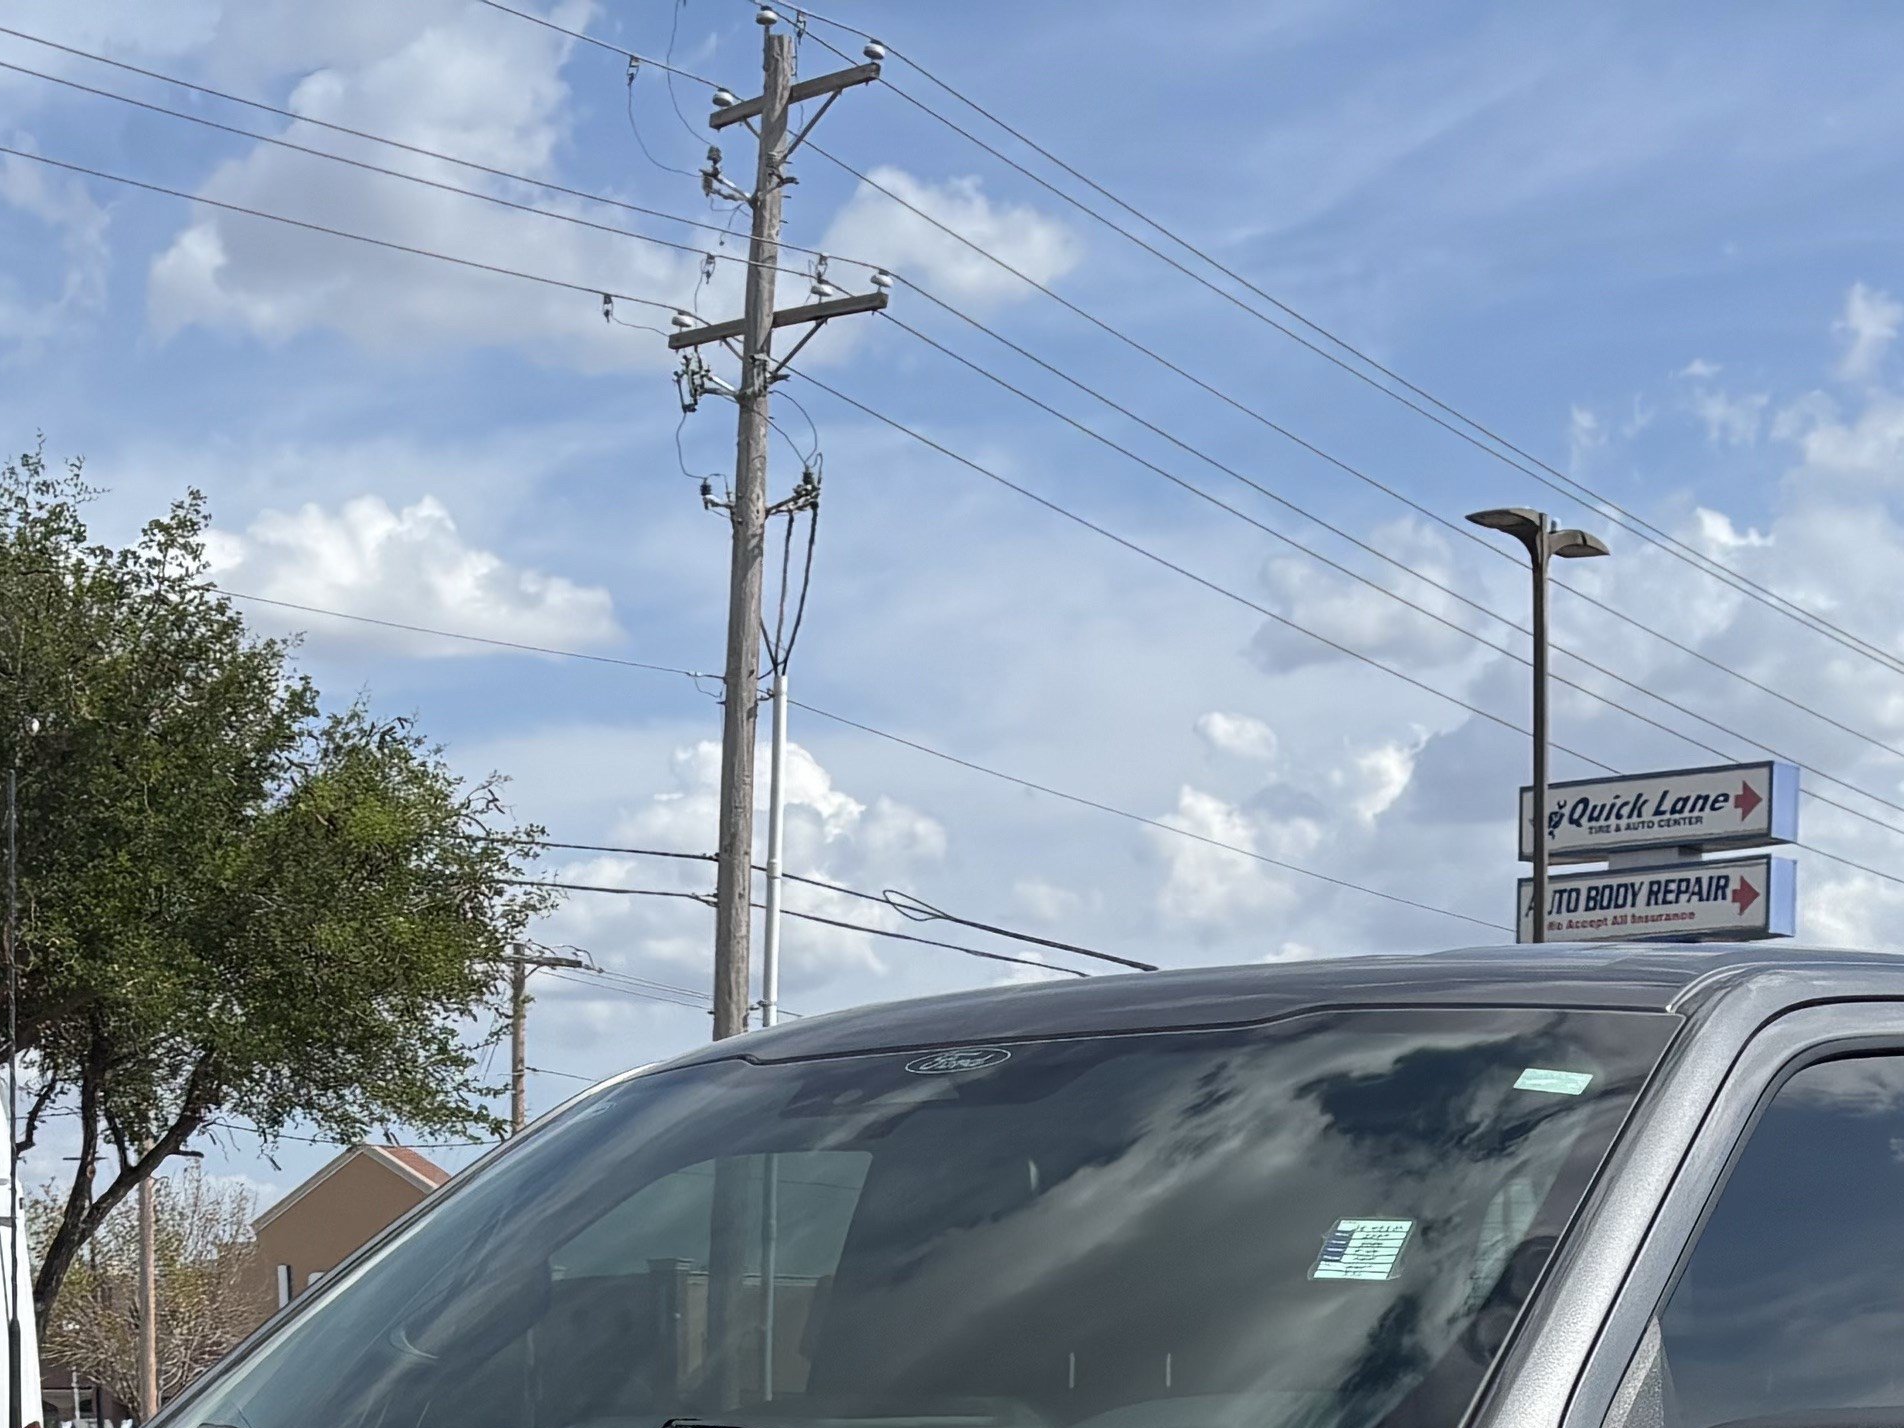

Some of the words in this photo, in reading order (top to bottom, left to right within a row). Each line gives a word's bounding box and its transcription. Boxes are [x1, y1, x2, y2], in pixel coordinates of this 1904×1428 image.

[1568, 793, 1648, 828] Quick
[1653, 790, 1730, 817] Lane
[1588, 824, 1612, 835] TIRE
[1625, 820, 1655, 831] AUTO
[1658, 816, 1703, 828] CENTER
[1584, 882, 1645, 912] BODY
[1646, 875, 1730, 907] REPAIR
